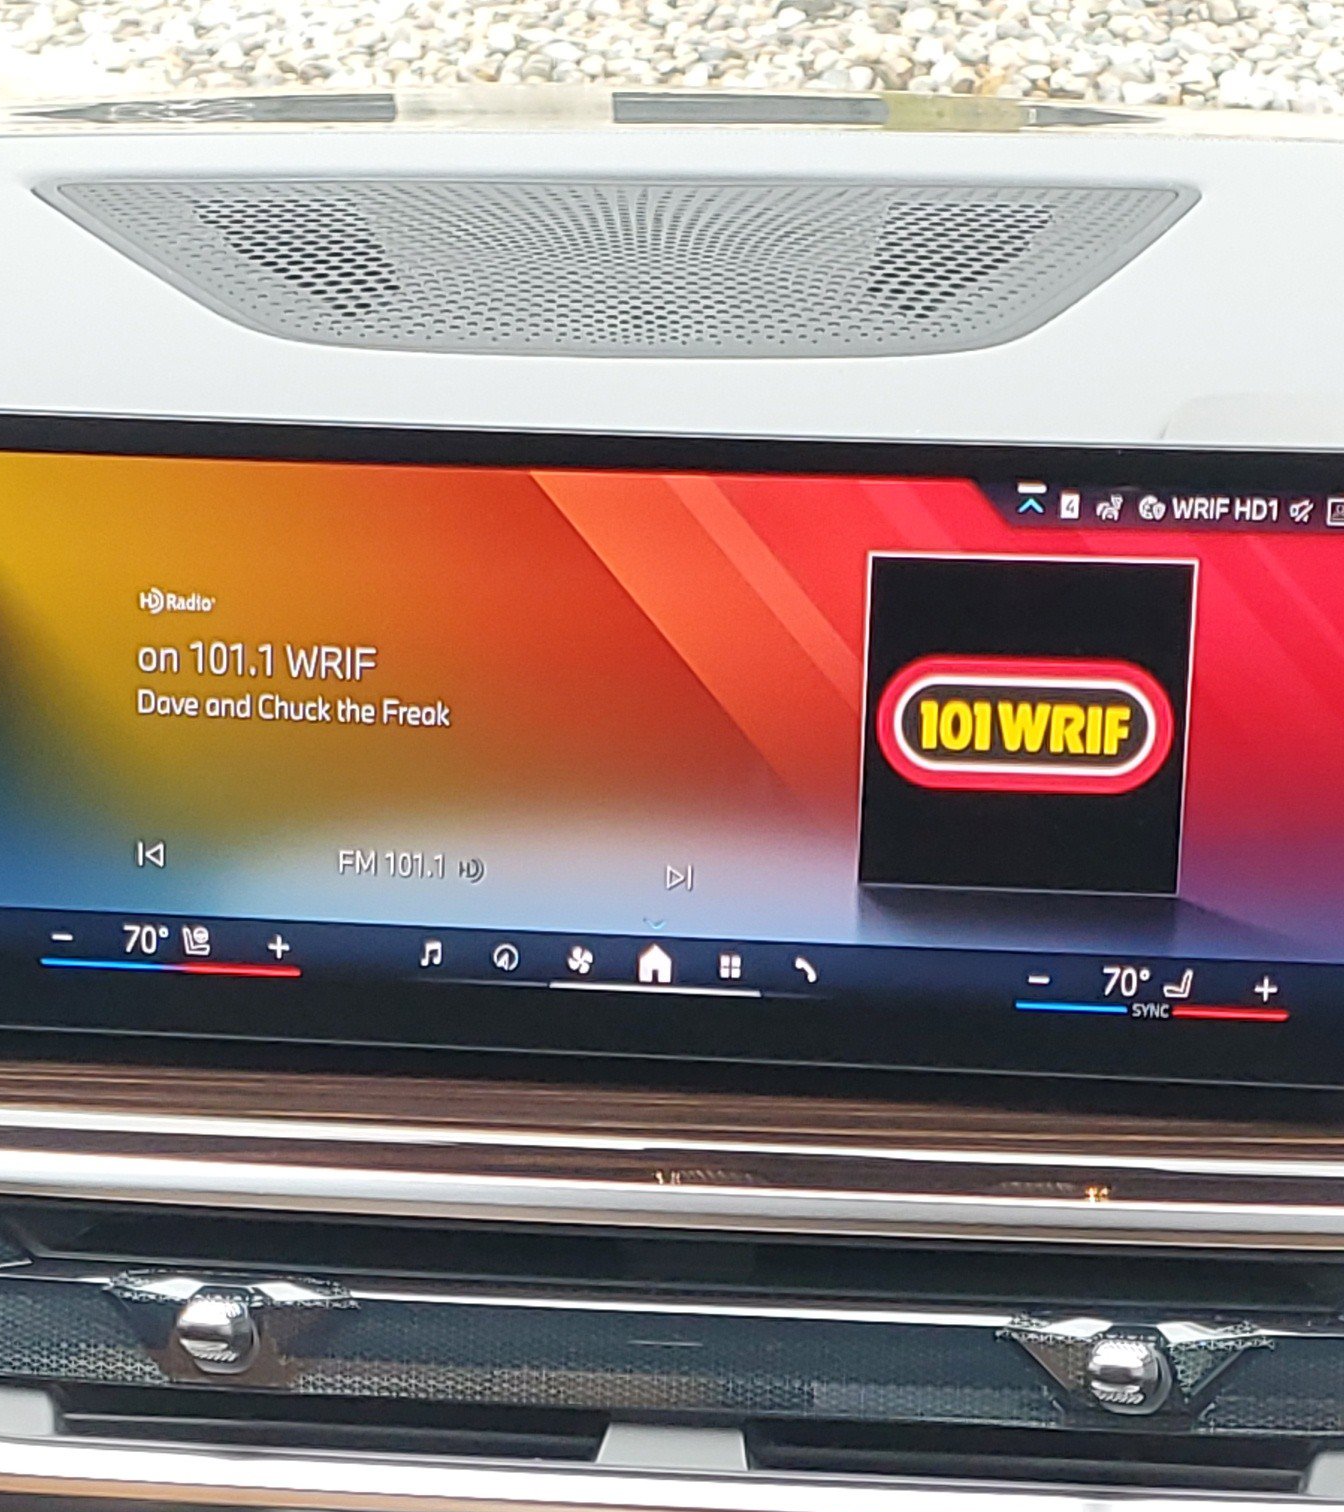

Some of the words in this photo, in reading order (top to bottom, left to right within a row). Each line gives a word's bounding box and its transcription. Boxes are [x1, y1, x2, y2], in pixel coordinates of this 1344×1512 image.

[1172, 497, 1230, 520] WRIF
[1234, 498, 1278, 522] HD1
[138, 646, 178, 673] on
[189, 641, 273, 677] 101.1
[285, 644, 378, 681] WRIF
[137, 689, 199, 715] Dave
[206, 693, 251, 719] and
[258, 693, 331, 723] Chuck
[336, 698, 375, 724] the
[382, 698, 451, 727] Freak
[920, 699, 992, 752] 101
[997, 701, 1131, 755] WRIF
[339, 850, 377, 876] FM
[385, 851, 445, 879] 101.1
[1132, 1003, 1169, 1018] SYNC
